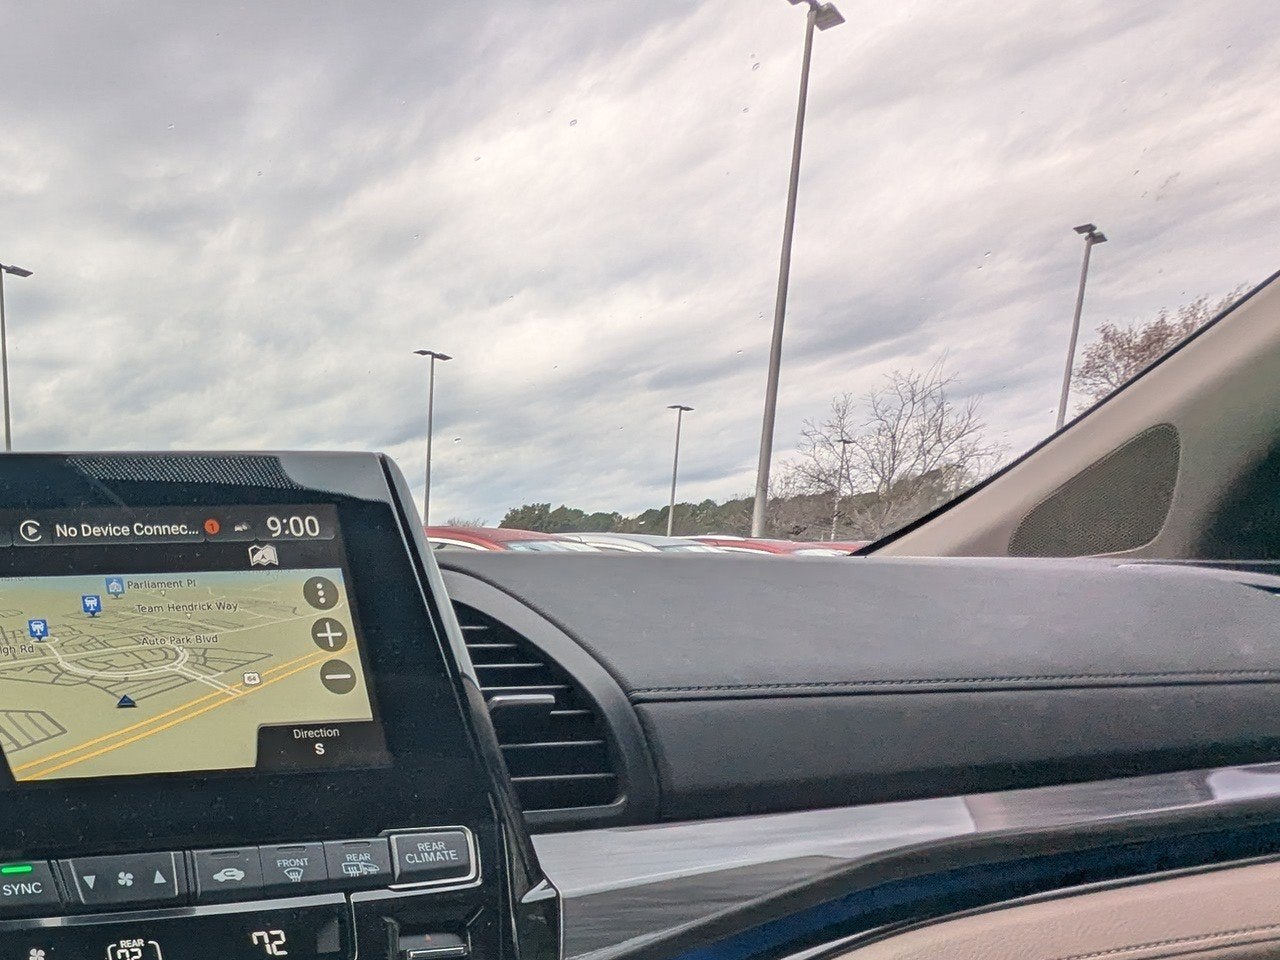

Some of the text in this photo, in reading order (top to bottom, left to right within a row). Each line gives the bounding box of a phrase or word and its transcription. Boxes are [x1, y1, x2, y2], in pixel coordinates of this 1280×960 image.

[55, 521, 200, 538] No Device Connec...
[266, 515, 320, 538] 9:00
[126, 579, 183, 590] Parliament
[136, 601, 239, 613] Team Hendrick Way
[141, 633, 219, 646] Auto Park Blvd
[19, 642, 35, 655] Rd
[293, 727, 340, 740] Direction
[314, 743, 325, 756] S
[416, 841, 447, 853] REAR
[276, 857, 310, 868] FRONT
[345, 852, 372, 863] REAR
[404, 849, 459, 864] CLIMATE
[2, 881, 44, 897] SYNC
[120, 938, 145, 949] REAR
[252, 929, 289, 956] 72
